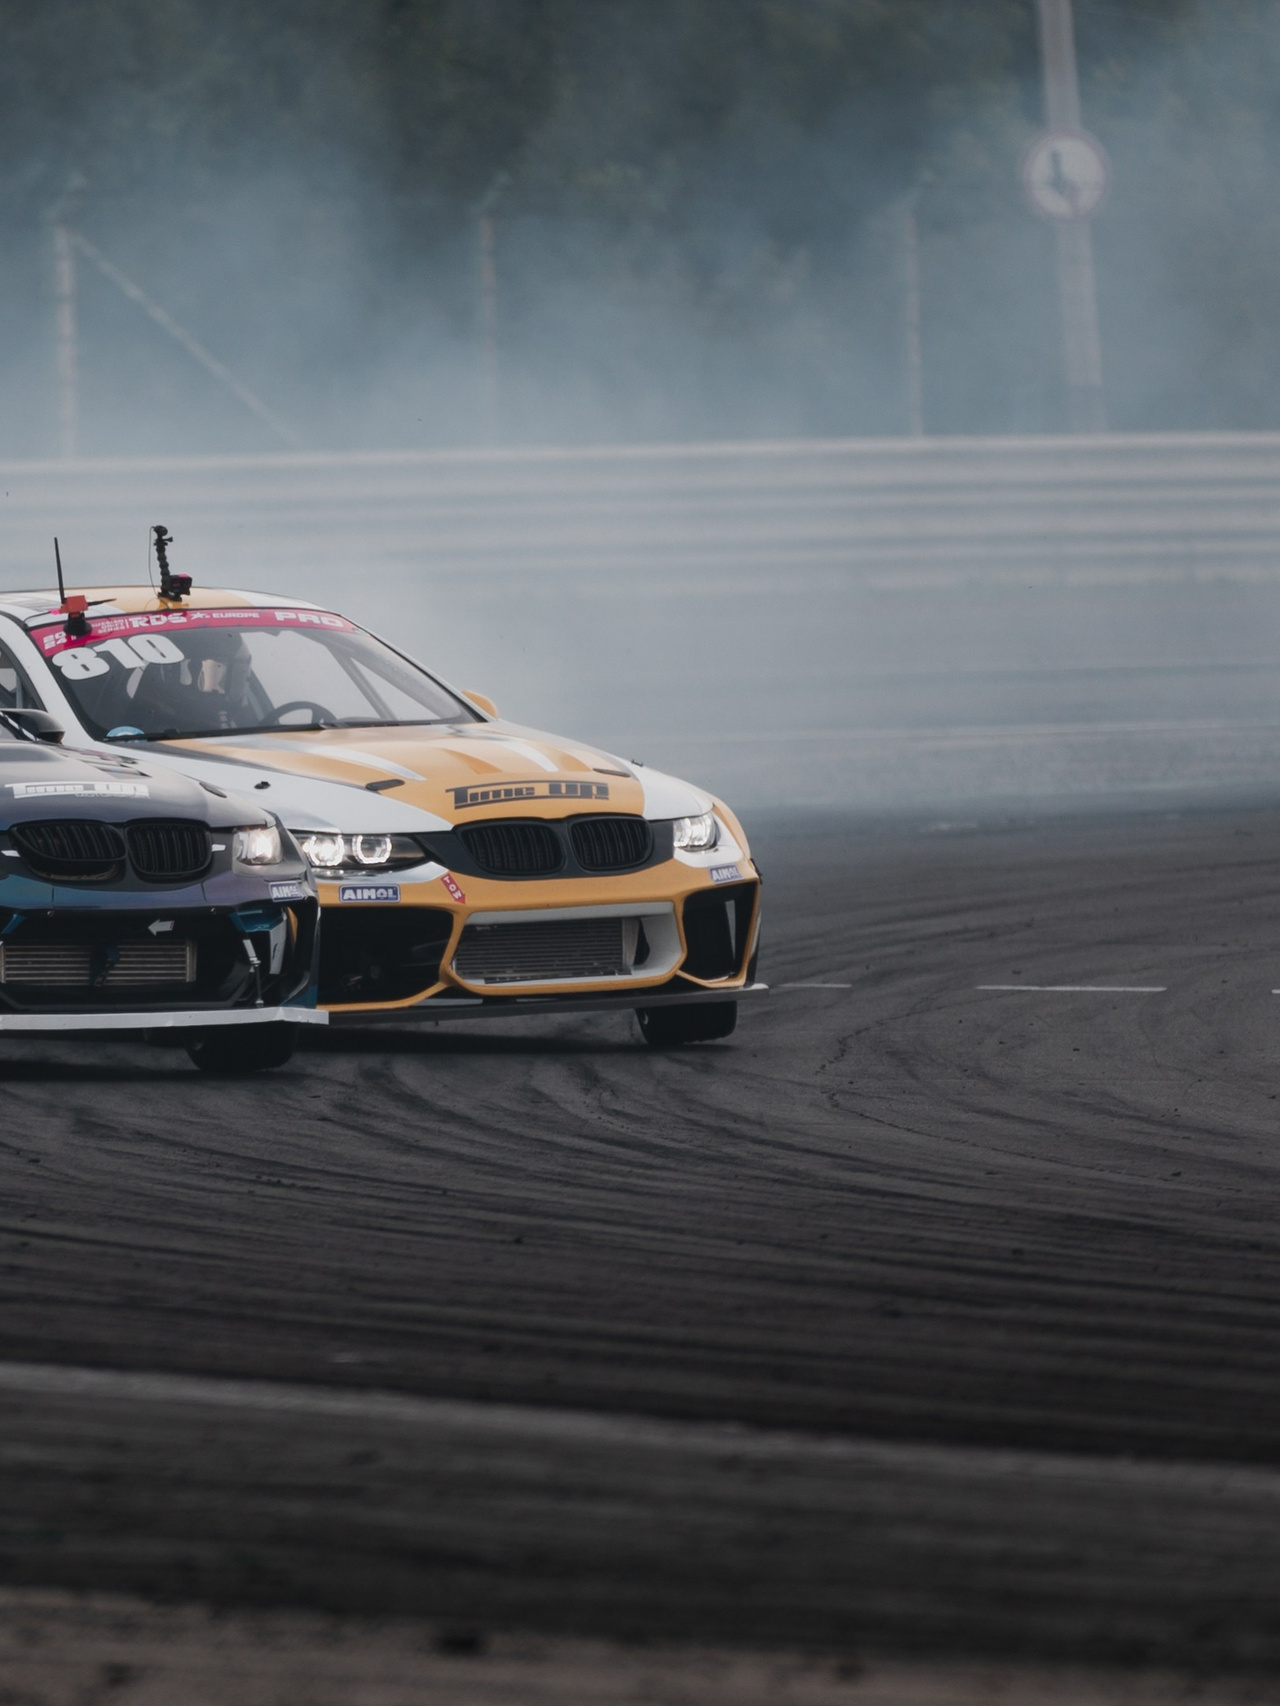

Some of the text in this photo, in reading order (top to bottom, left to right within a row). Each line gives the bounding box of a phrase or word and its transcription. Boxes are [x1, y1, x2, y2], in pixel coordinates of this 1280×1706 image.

[129, 612, 188, 628] RDS
[274, 611, 345, 627] PRO
[51, 633, 185, 680] 810
[341, 888, 397, 900] AIMOL
